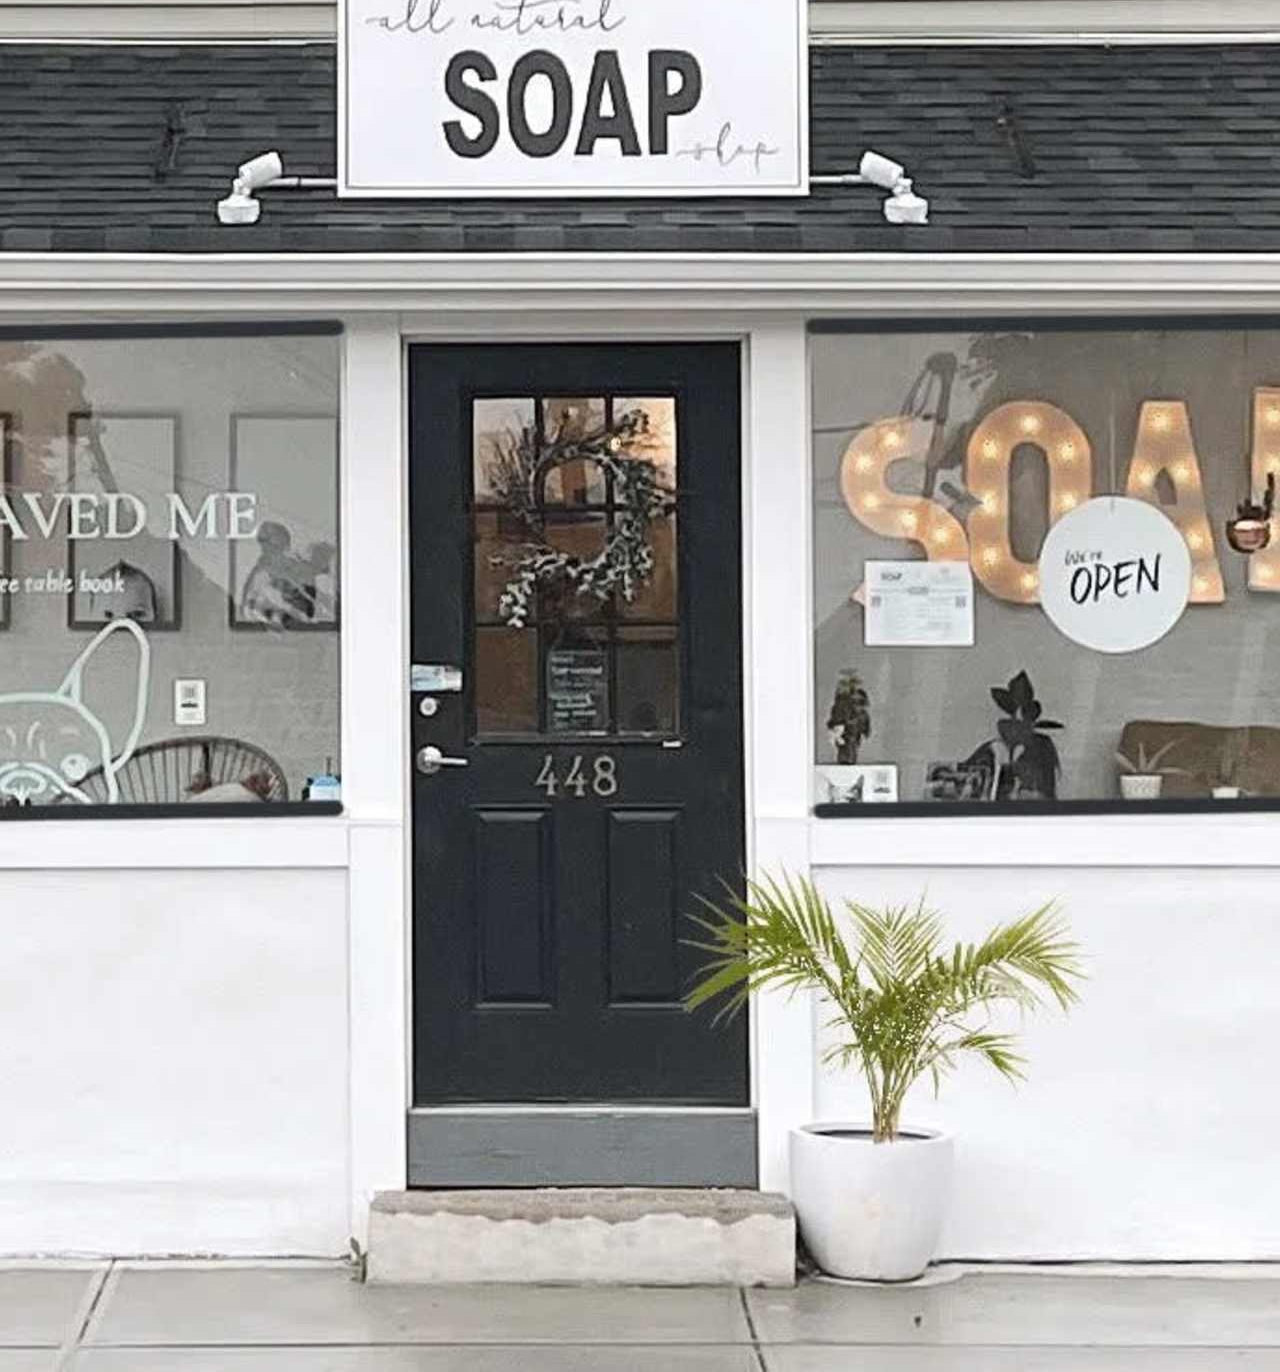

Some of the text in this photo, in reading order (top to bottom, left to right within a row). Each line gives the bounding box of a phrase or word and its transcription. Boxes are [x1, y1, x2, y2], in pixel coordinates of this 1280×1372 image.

[441, 49, 703, 159] SOAP
[165, 492, 262, 542] ME
[24, 569, 74, 593] table
[79, 568, 125, 593] book
[1070, 552, 1161, 605] OPEN
[534, 755, 617, 797] 448
